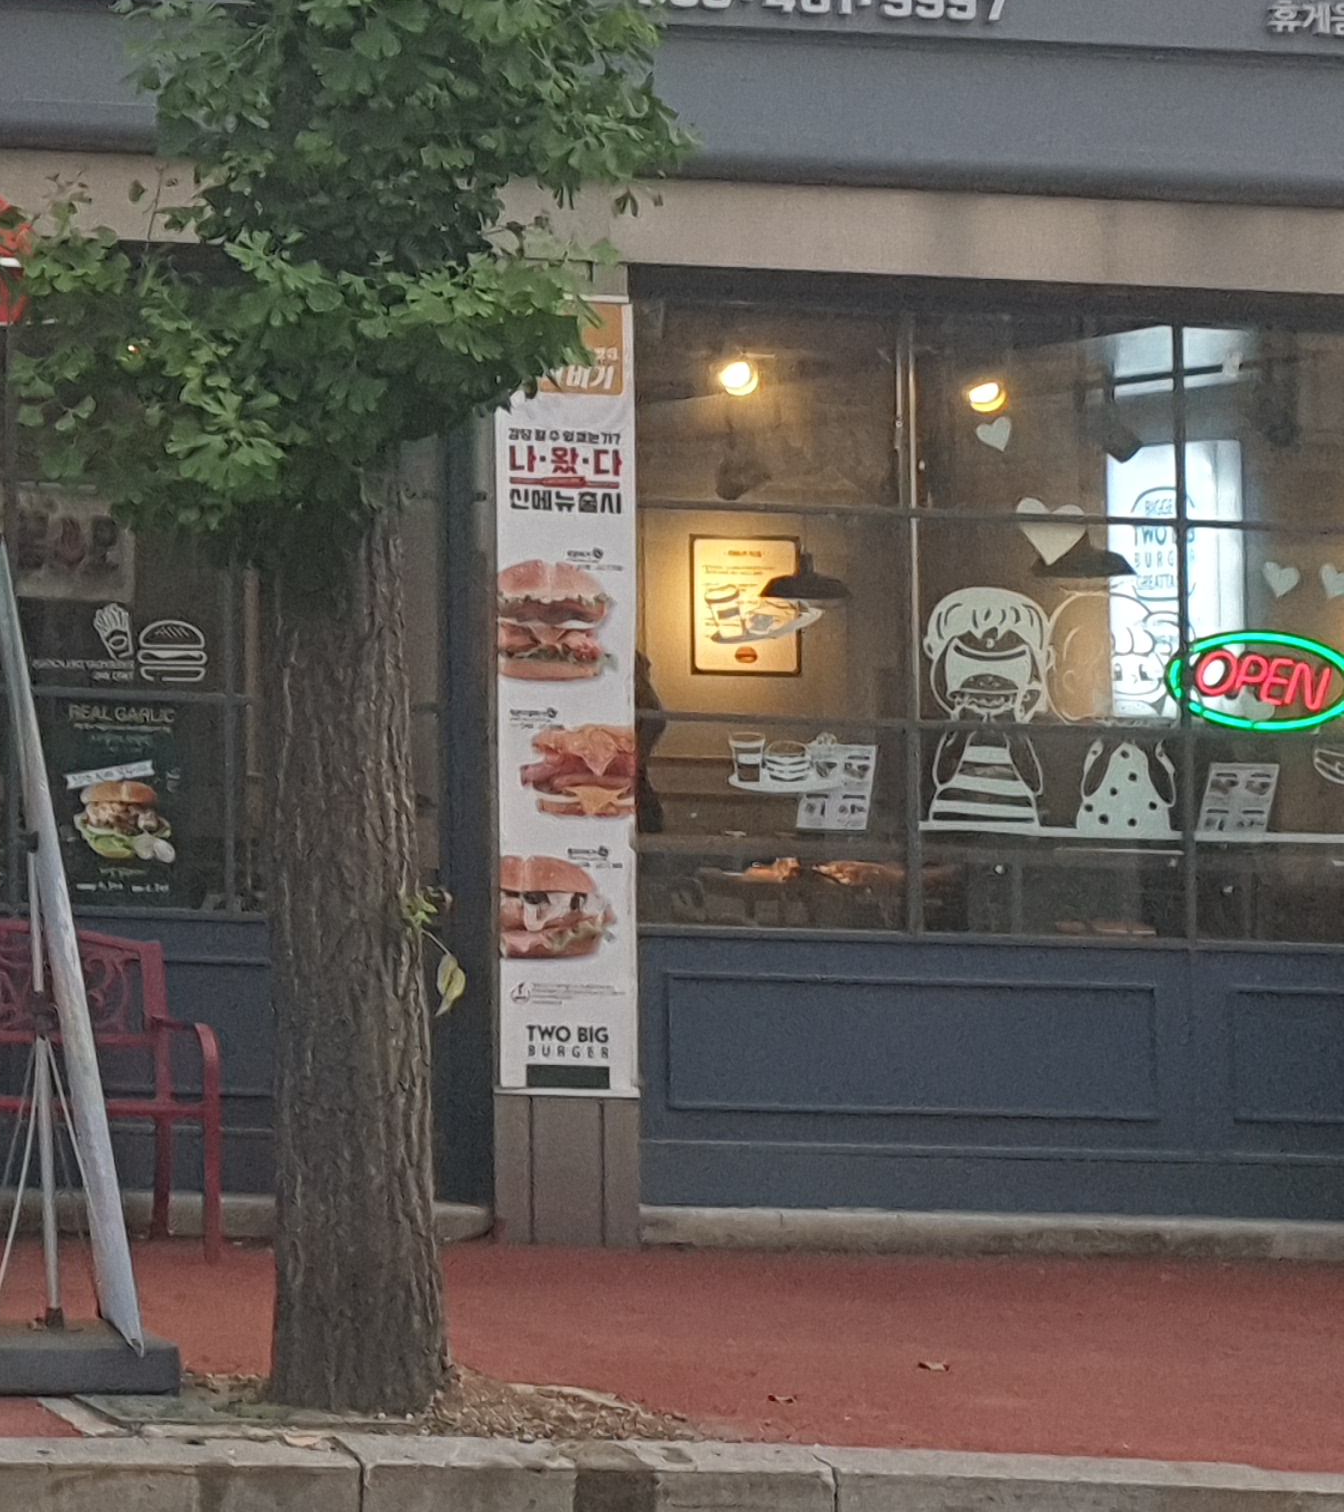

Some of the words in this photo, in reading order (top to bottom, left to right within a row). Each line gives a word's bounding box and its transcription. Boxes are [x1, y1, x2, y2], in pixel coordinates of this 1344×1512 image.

[1194, 648, 1332, 713] OPEN
[525, 1024, 572, 1044] TWO
[576, 1025, 610, 1045] BIG
[527, 1044, 610, 1060] BURGER
